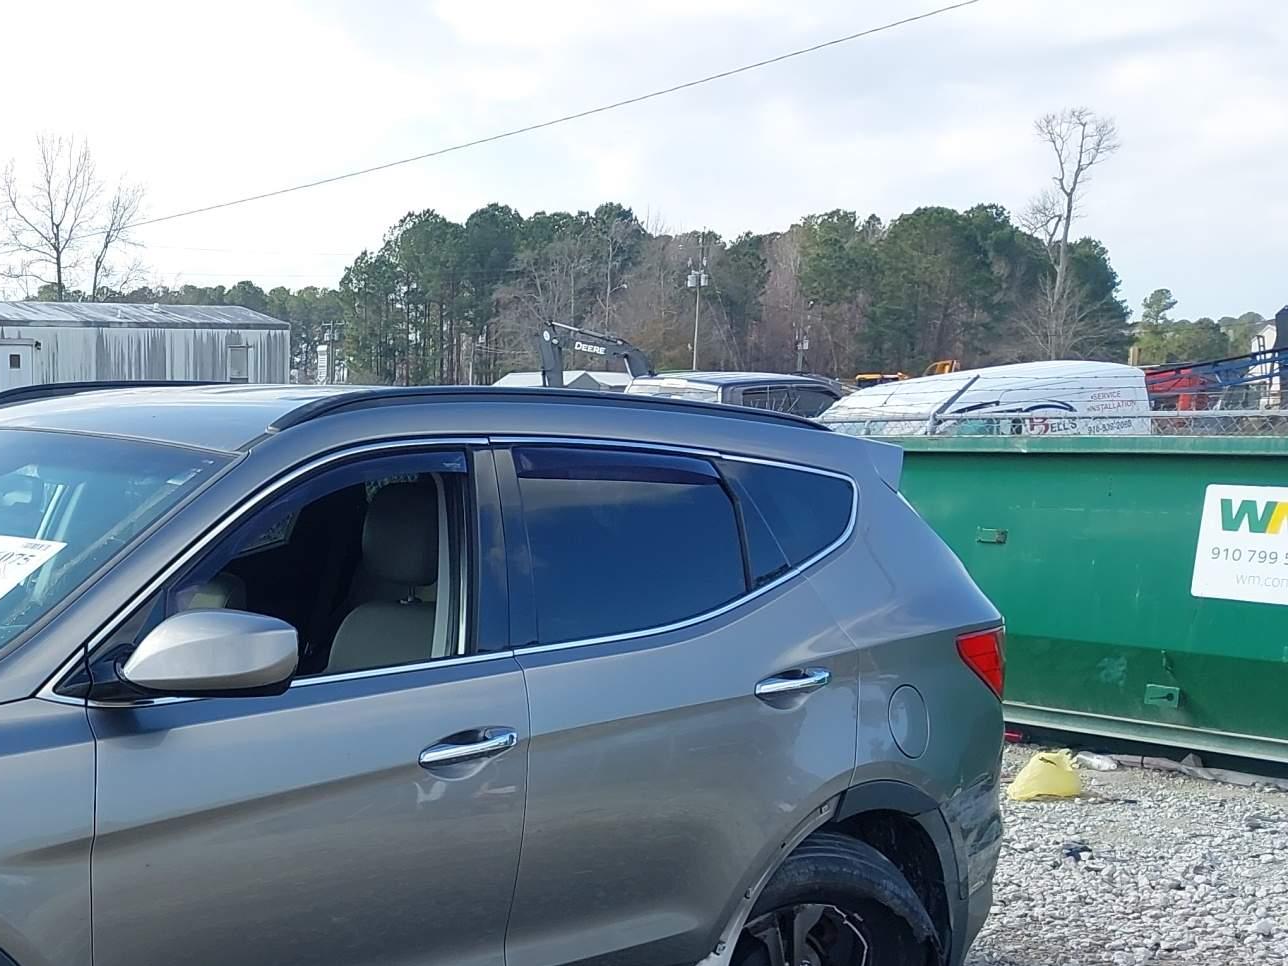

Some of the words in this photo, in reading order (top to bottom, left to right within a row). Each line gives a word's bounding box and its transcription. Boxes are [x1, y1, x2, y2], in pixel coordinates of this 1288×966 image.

[574, 341, 607, 355] DEERE
[1091, 390, 1121, 401] SERVICE
[1211, 546, 1243, 562] 910
[1247, 549, 1279, 565] 799
